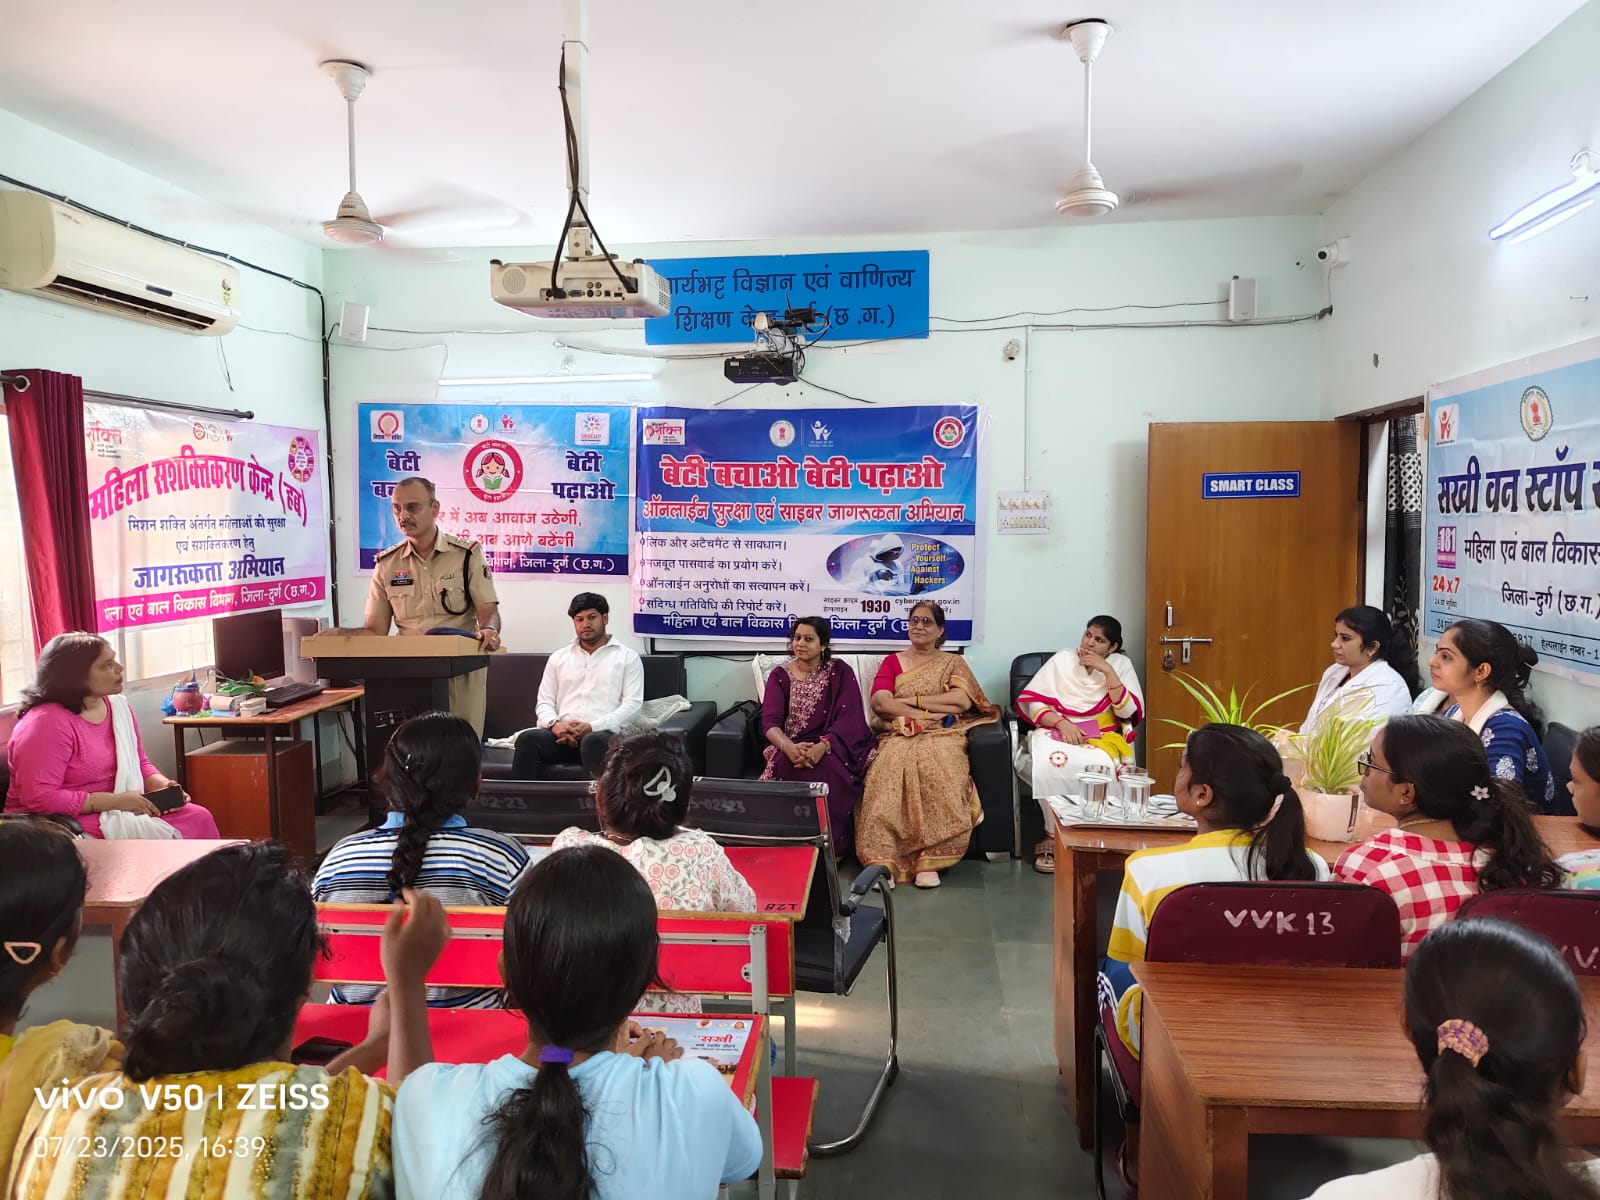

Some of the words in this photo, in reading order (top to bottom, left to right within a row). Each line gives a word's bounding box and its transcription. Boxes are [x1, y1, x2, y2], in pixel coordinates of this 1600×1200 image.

[732, 267, 796, 293] विज्ञान
[803, 264, 832, 292] एवं
[839, 263, 916, 288] वाणिज्य
[674, 305, 734, 332] शिक्षण
[386, 450, 421, 472] बेटी
[566, 450, 602, 473] बेटी
[660, 455, 709, 488] बेटी
[712, 456, 799, 488] बचाओ
[804, 457, 853, 488] बेटी
[857, 456, 945, 495] पढ़ाओ
[1210, 480, 1253, 492] SMART
[1255, 479, 1294, 491] CLASS
[1437, 455, 1482, 514] सखी
[1486, 469, 1521, 513] वन
[1525, 445, 1587, 512] स्टॉप
[89, 466, 150, 520] महिला
[247, 454, 274, 501] केन्द्र
[551, 479, 616, 503] पढ़ाओ
[449, 508, 461, 523] में
[465, 512, 487, 525] अब
[492, 512, 536, 526] आवाज
[541, 509, 582, 527] उठेगी,
[643, 495, 708, 522] ऑनलाईन
[712, 501, 751, 526] सुरक्षा
[755, 497, 775, 523] एवं
[779, 503, 823, 523] साइबर
[906, 497, 965, 522] अभियान
[128, 515, 156, 531] मिशन
[160, 515, 186, 530] शक्ति
[189, 514, 217, 530] अंतर्गत
[219, 514, 252, 529] महिलाओं
[254, 514, 265, 528] की
[267, 518, 286, 532] सुरक्षा
[176, 537, 189, 553] एवं
[243, 534, 255, 553] हेतु
[478, 534, 498, 547] अब
[502, 532, 533, 547] आगे
[670, 537, 688, 549] और
[733, 537, 742, 549] से
[911, 543, 940, 551] Protect
[1439, 527, 1456, 552] 181
[1464, 531, 1496, 564] महिला
[1500, 531, 1517, 564] एवं
[1521, 540, 1548, 563] बाल
[229, 554, 285, 580] अभियान
[520, 553, 569, 573] जिला-दुर्ग
[573, 557, 614, 571] (छ.ग.)
[679, 557, 714, 569] पासवार्ड
[718, 559, 731, 570] का
[733, 558, 758, 571] प्रयोग
[915, 554, 946, 562] Yourself
[910, 565, 940, 574] Against
[646, 576, 690, 591] ऑनलाईन
[693, 578, 730, 594] अनुरोधों
[732, 580, 745, 591] का
[748, 581, 785, 592] सत्यापन
[128, 597, 145, 621] एवं
[147, 601, 170, 616] बाल
[173, 593, 207, 613] विकास
[210, 590, 237, 609] विभाग,
[240, 585, 282, 606] जिला-दुर्ग
[284, 581, 317, 600] (छ.ग.)
[679, 598, 718, 611] गतिविधि
[721, 599, 733, 612] की
[736, 599, 764, 612] रिपोर्ट
[861, 599, 891, 613] 1930
[1502, 581, 1552, 616] जिला-दुर्ग
[663, 611, 698, 629] महिला
[702, 612, 717, 629] एवं
[720, 616, 743, 628] बाल
[747, 612, 784, 629] विकास
[830, 615, 886, 636] जिला-दुर्ग
[1224, 909, 1297, 935] VVK
[1306, 911, 1336, 936] 13
